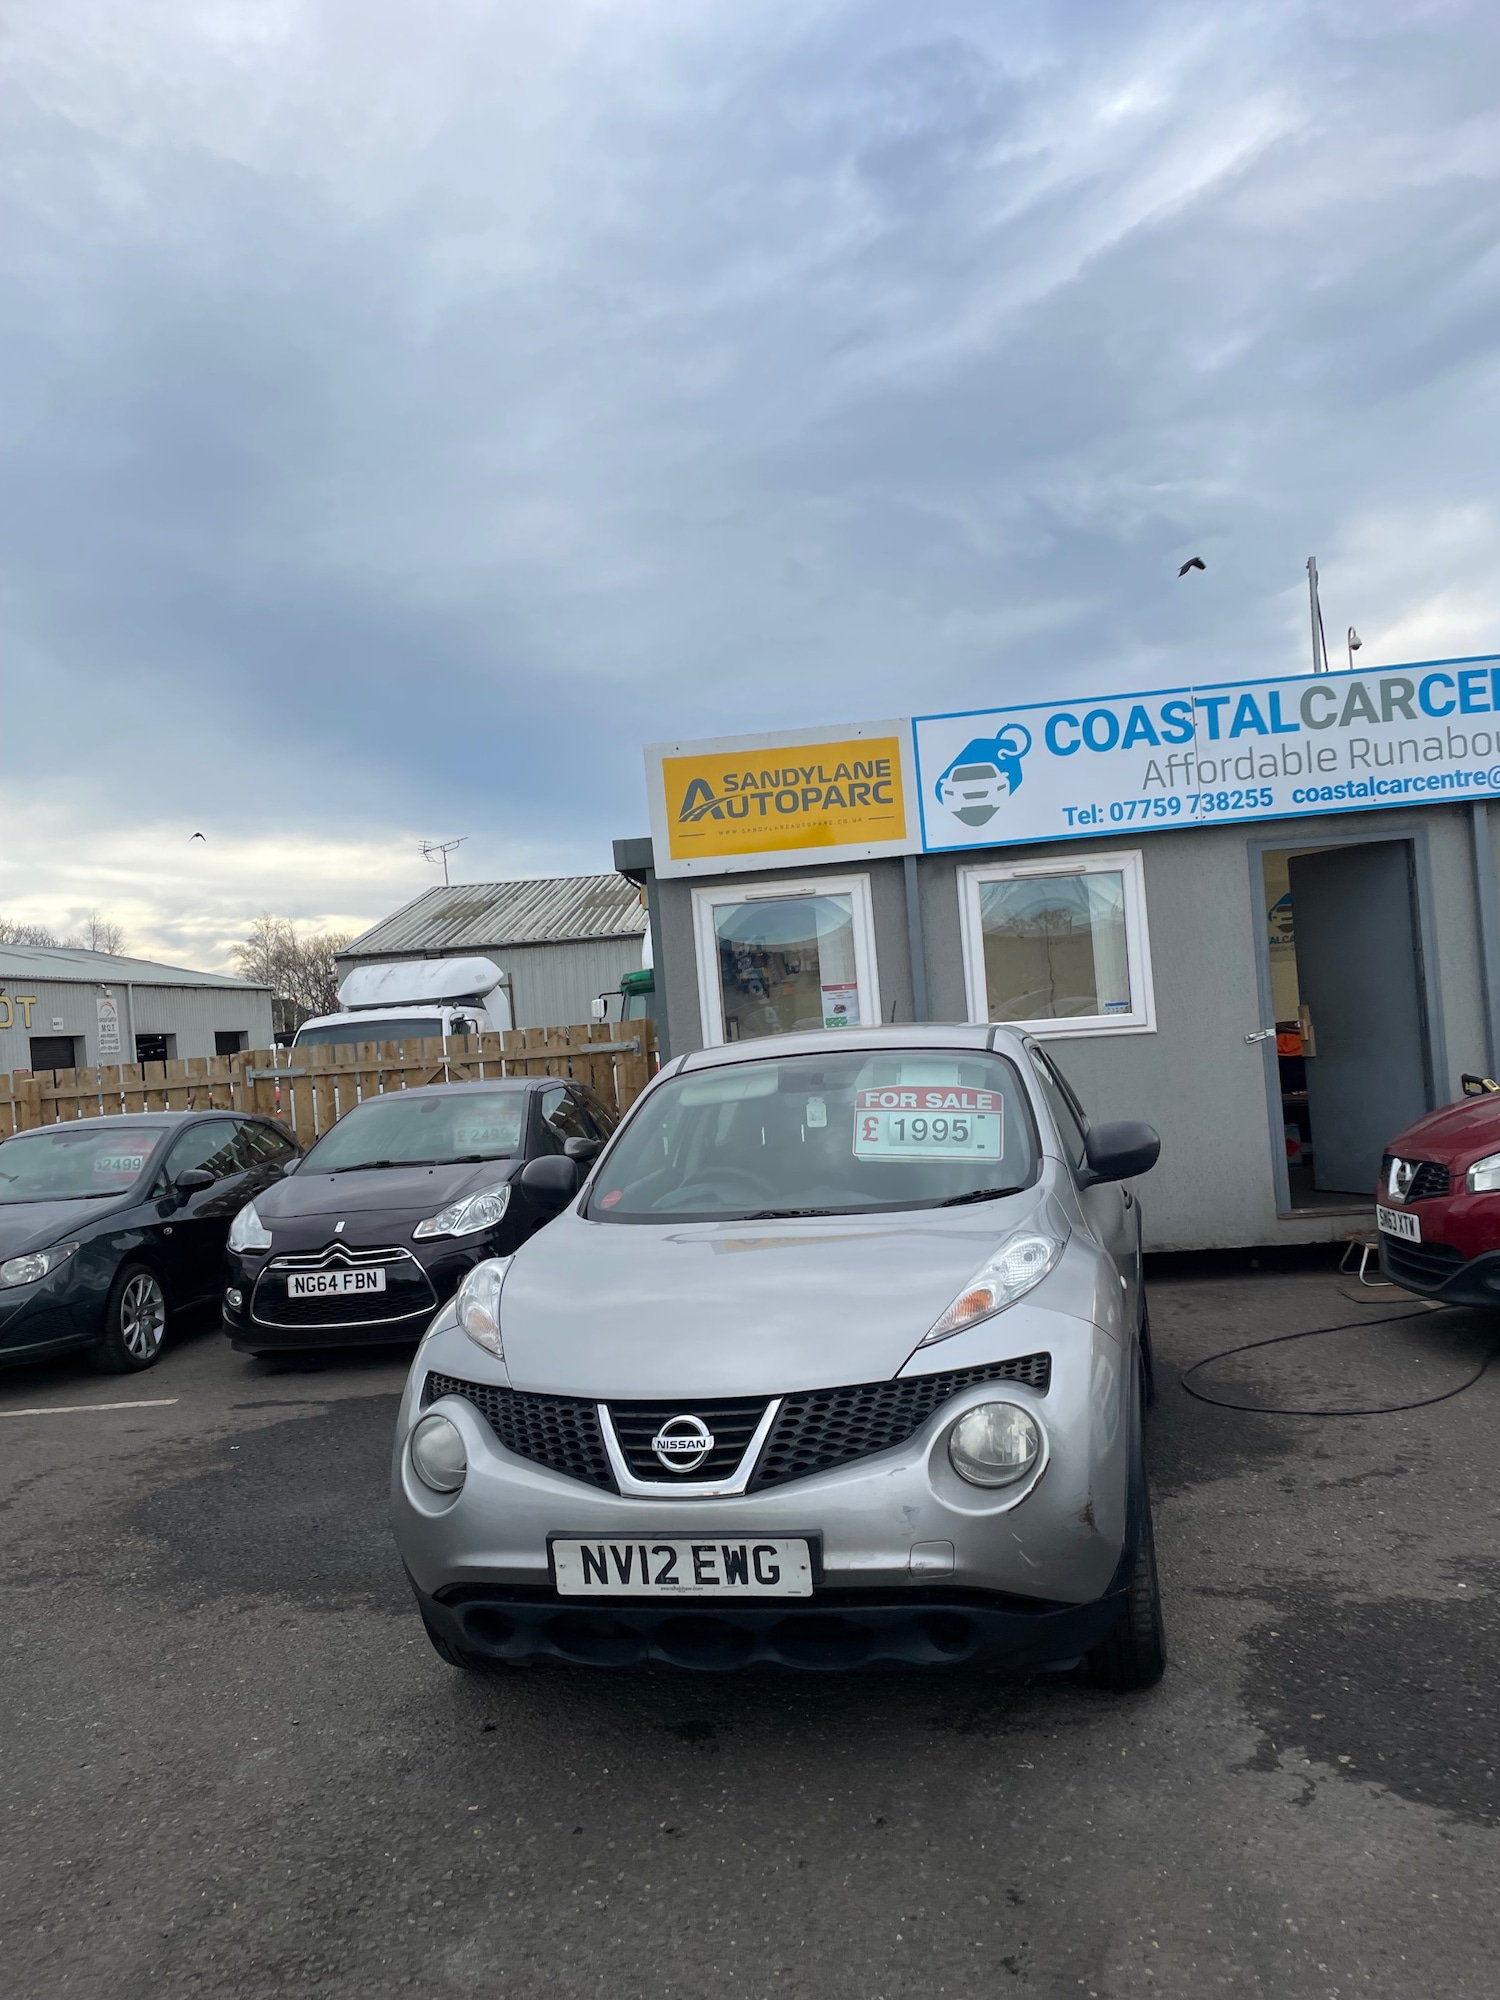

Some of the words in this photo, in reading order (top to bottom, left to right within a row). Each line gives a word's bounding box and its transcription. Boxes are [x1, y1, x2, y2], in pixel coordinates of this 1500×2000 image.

[1142, 740, 1337, 790] Affordable
[1349, 726, 1500, 770] Runabo
[723, 759, 891, 792] SANDYLANE
[678, 778, 894, 823] AUTOPARC
[1062, 804, 1104, 826] Tel:
[1109, 796, 1181, 822] 07759
[1186, 787, 1273, 814] 738255
[865, 1092, 918, 1108] FOR
[925, 1093, 993, 1110] SALE
[862, 1116, 880, 1142] £
[894, 1118, 969, 1142] 1995
[295, 1274, 338, 1293] NG64
[343, 1271, 377, 1290] FBN
[657, 1439, 706, 1449] NISSAN
[580, 1544, 680, 1585] NV12
[691, 1544, 781, 1585] EWG
